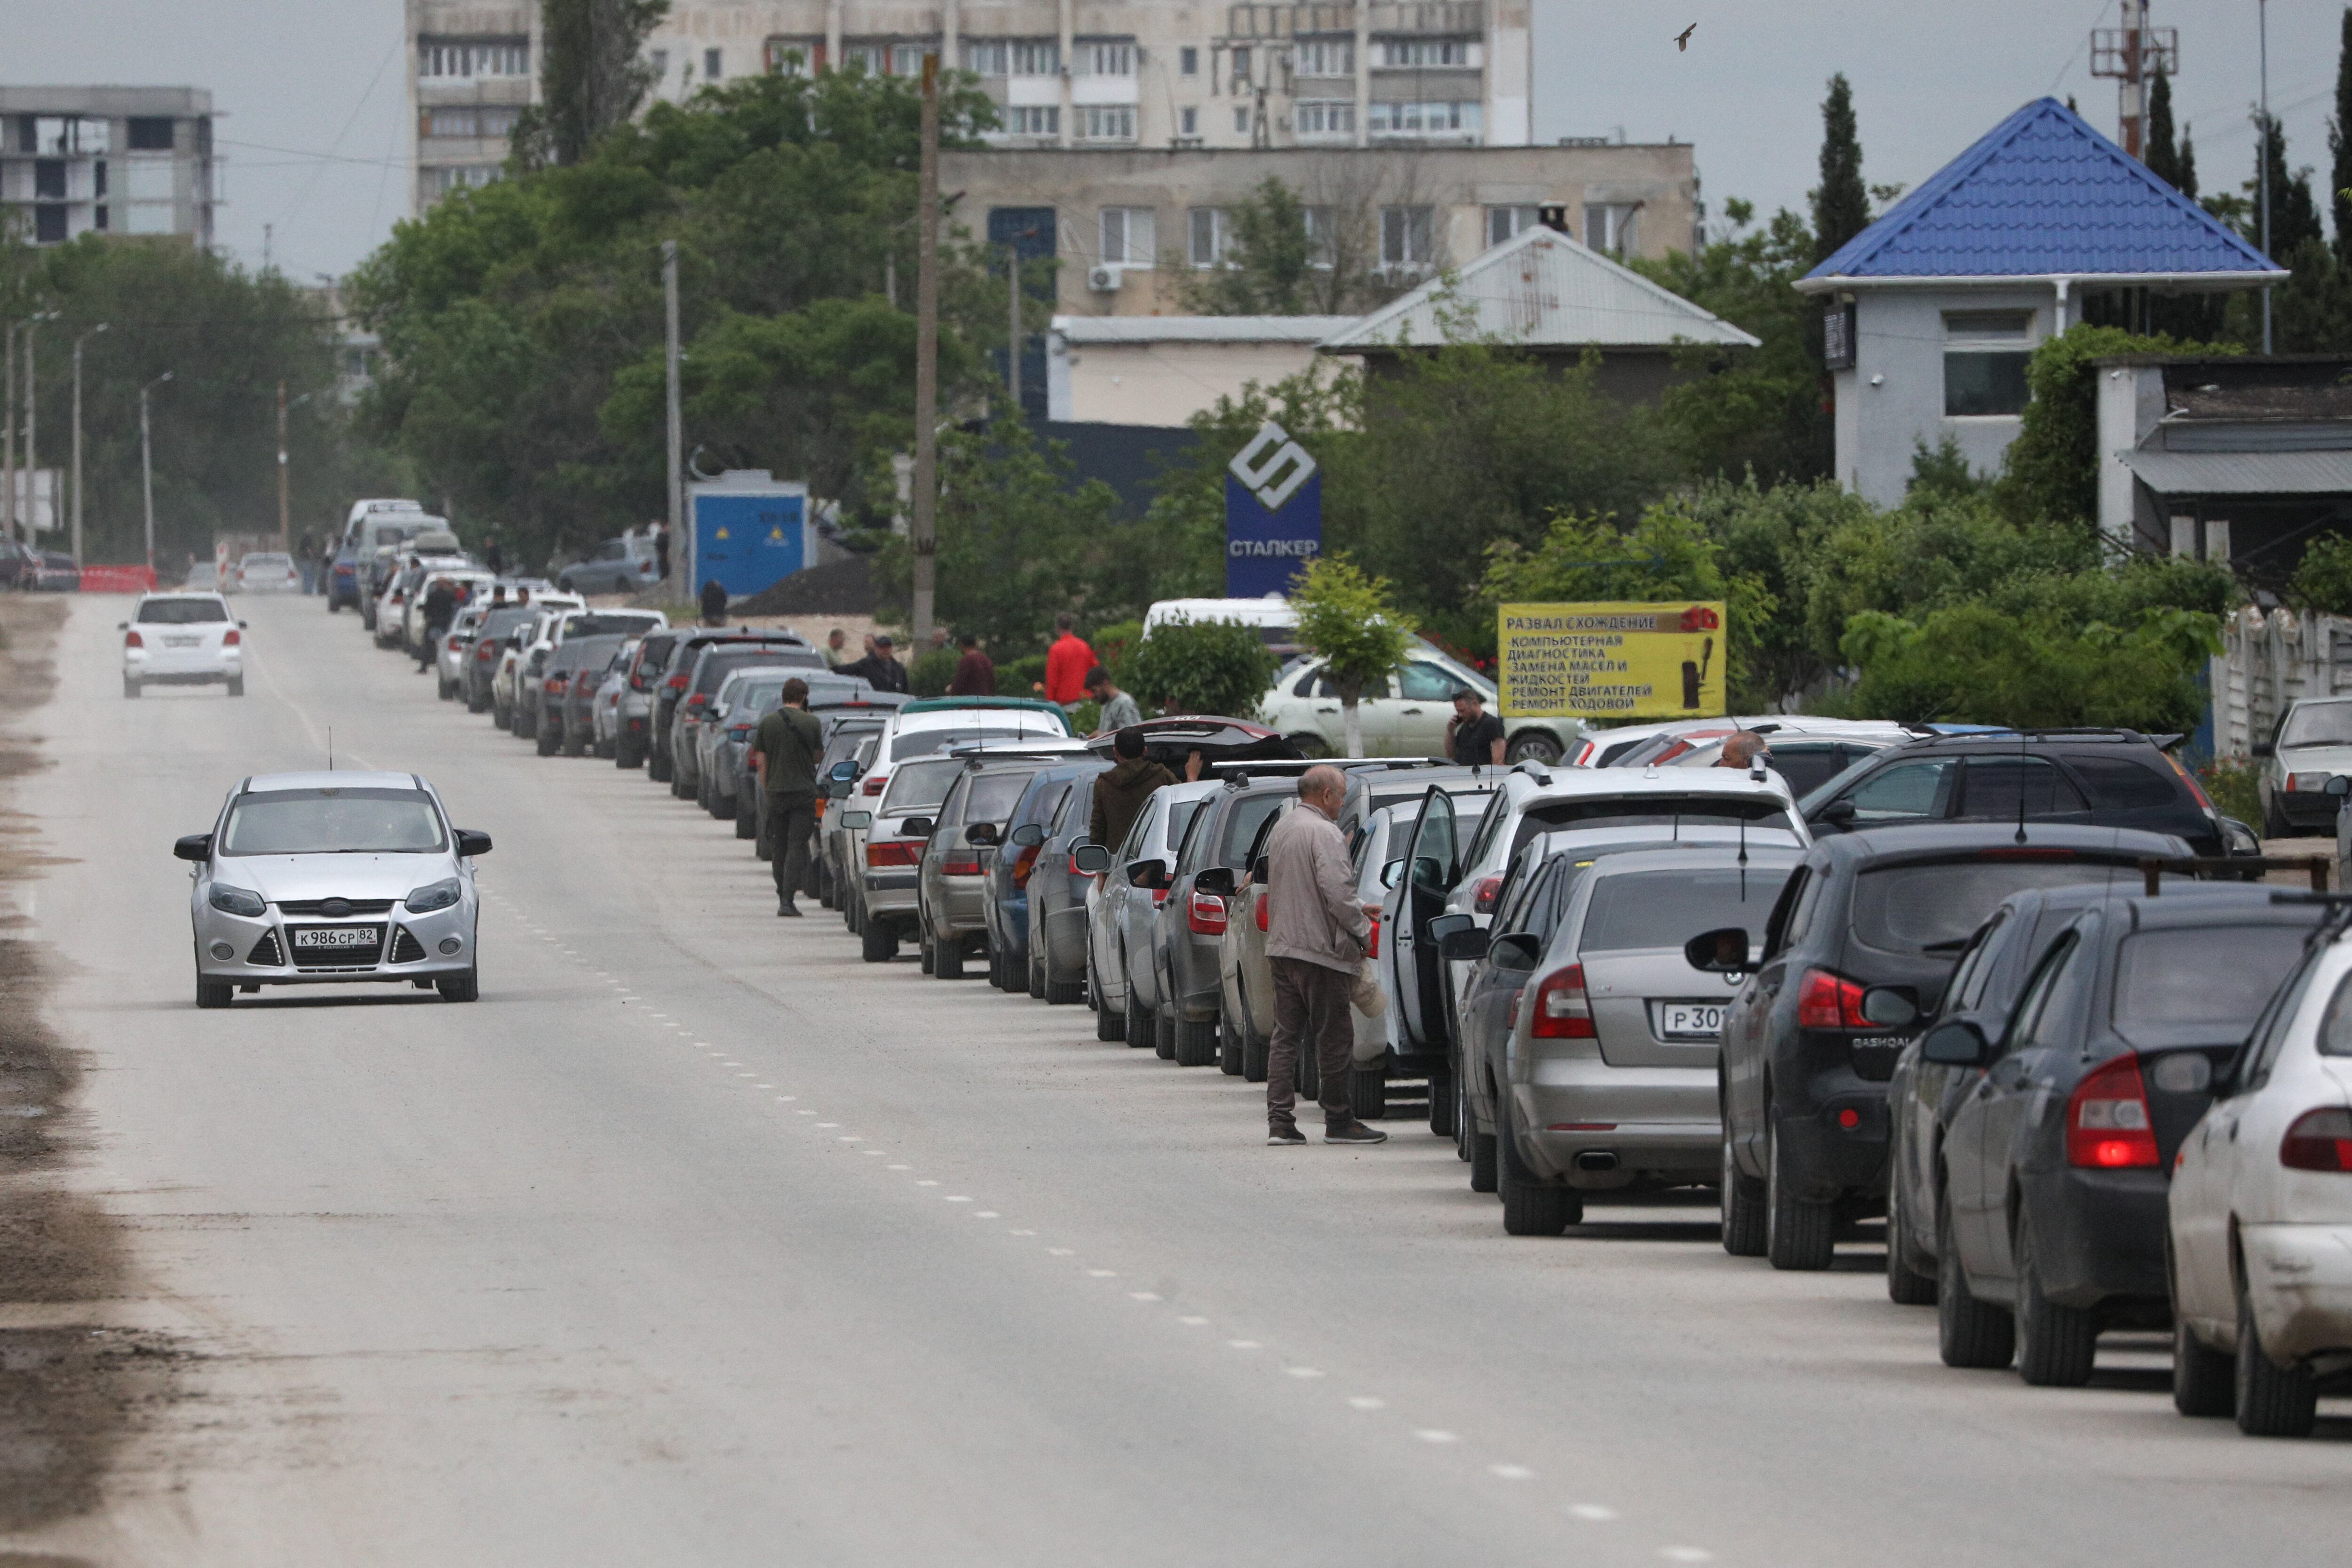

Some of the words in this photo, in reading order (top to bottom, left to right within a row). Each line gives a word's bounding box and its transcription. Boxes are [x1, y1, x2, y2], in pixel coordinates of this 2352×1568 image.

[1229, 539, 1318, 557] СТАЛКЕР
[1507, 617, 1563, 629] РАЗВАЛ
[1566, 616, 1657, 631] СХОЖДЕНИЕ
[1507, 647, 1605, 661] ДИАГНОСТИКА
[1570, 660, 1615, 672] МАСЕЛ
[1617, 660, 1628, 672] И
[1507, 672, 1590, 685] ЖИДКОСТЕЙ
[1569, 684, 1653, 697] ДВИГАТЕЛЕЙ
[1569, 697, 1635, 711] ХОДОВОЙ
